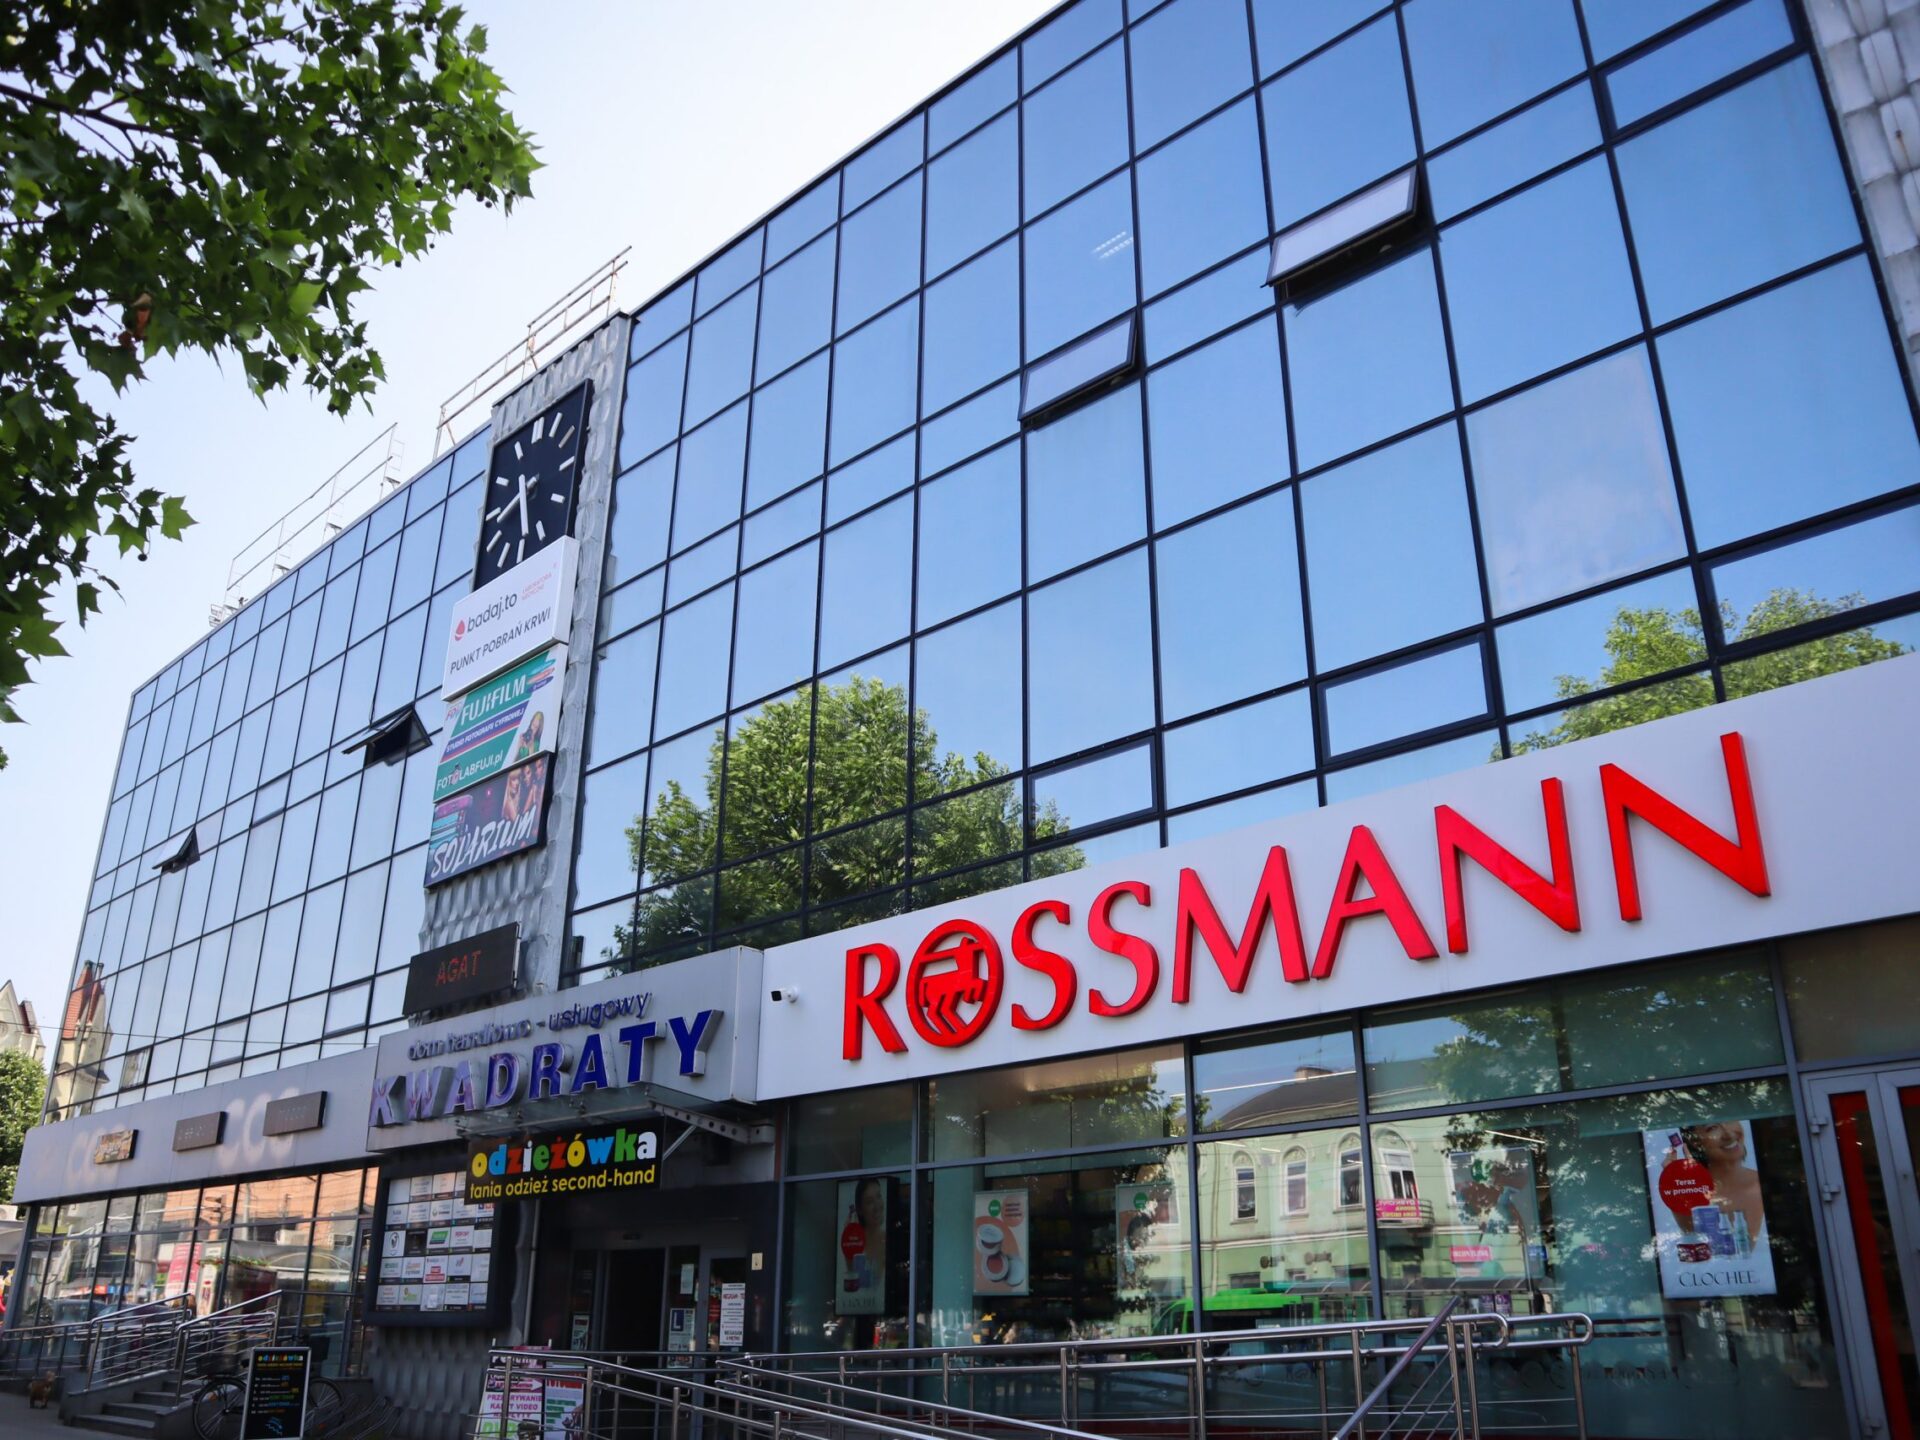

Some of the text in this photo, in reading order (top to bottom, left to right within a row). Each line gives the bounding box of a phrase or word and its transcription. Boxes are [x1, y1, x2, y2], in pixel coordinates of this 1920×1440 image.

[467, 593, 518, 634] badaj.to
[450, 606, 552, 675] PUNKT POBRAŃ KRWI
[460, 674, 526, 726] FUJIFILM
[430, 804, 537, 879] SOLARIUM
[840, 731, 1772, 1061] ROSSMANN
[435, 950, 482, 987] AGAT
[408, 1033, 443, 1061] dom
[549, 991, 653, 1032] usługowy
[368, 1009, 725, 1128] KWADRATY
[471, 1127, 658, 1178] odzieżówka
[470, 1179, 502, 1199] tania
[505, 1175, 549, 1196] odzież
[551, 1164, 656, 1193] second-hand
[1675, 1178, 1696, 1186] Teraz
[1679, 1270, 1760, 1288] CLOCHEE
